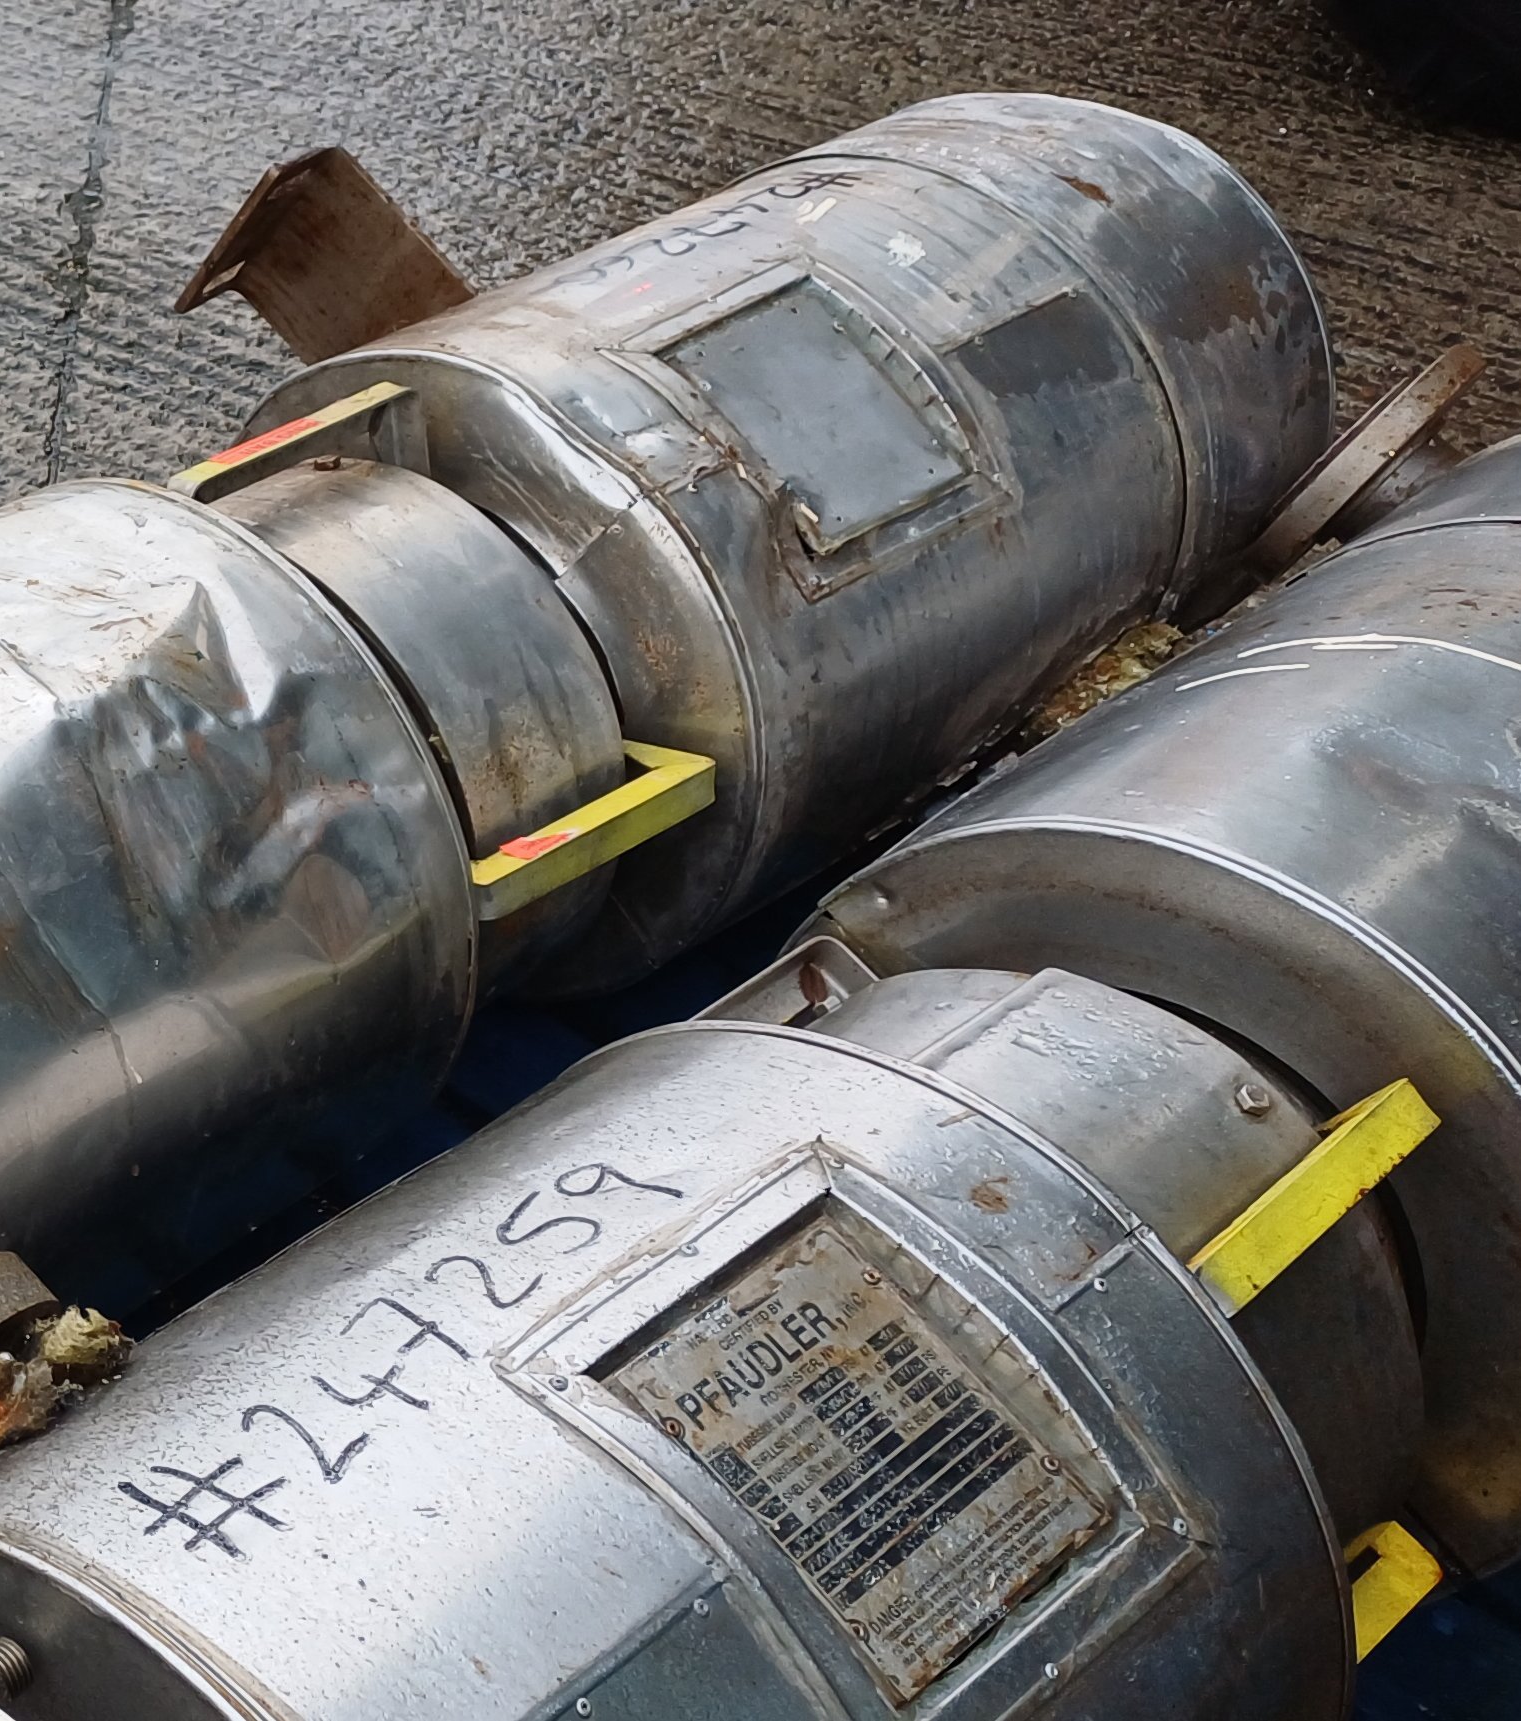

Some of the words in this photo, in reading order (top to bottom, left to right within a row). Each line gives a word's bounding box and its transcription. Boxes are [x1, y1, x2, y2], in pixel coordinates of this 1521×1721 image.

[117, 1162, 685, 1560] #247259
[674, 1301, 847, 1430] PFAUDLER,
[715, 1306, 772, 1353] CERTIFIED
[764, 1296, 786, 1316] BY
